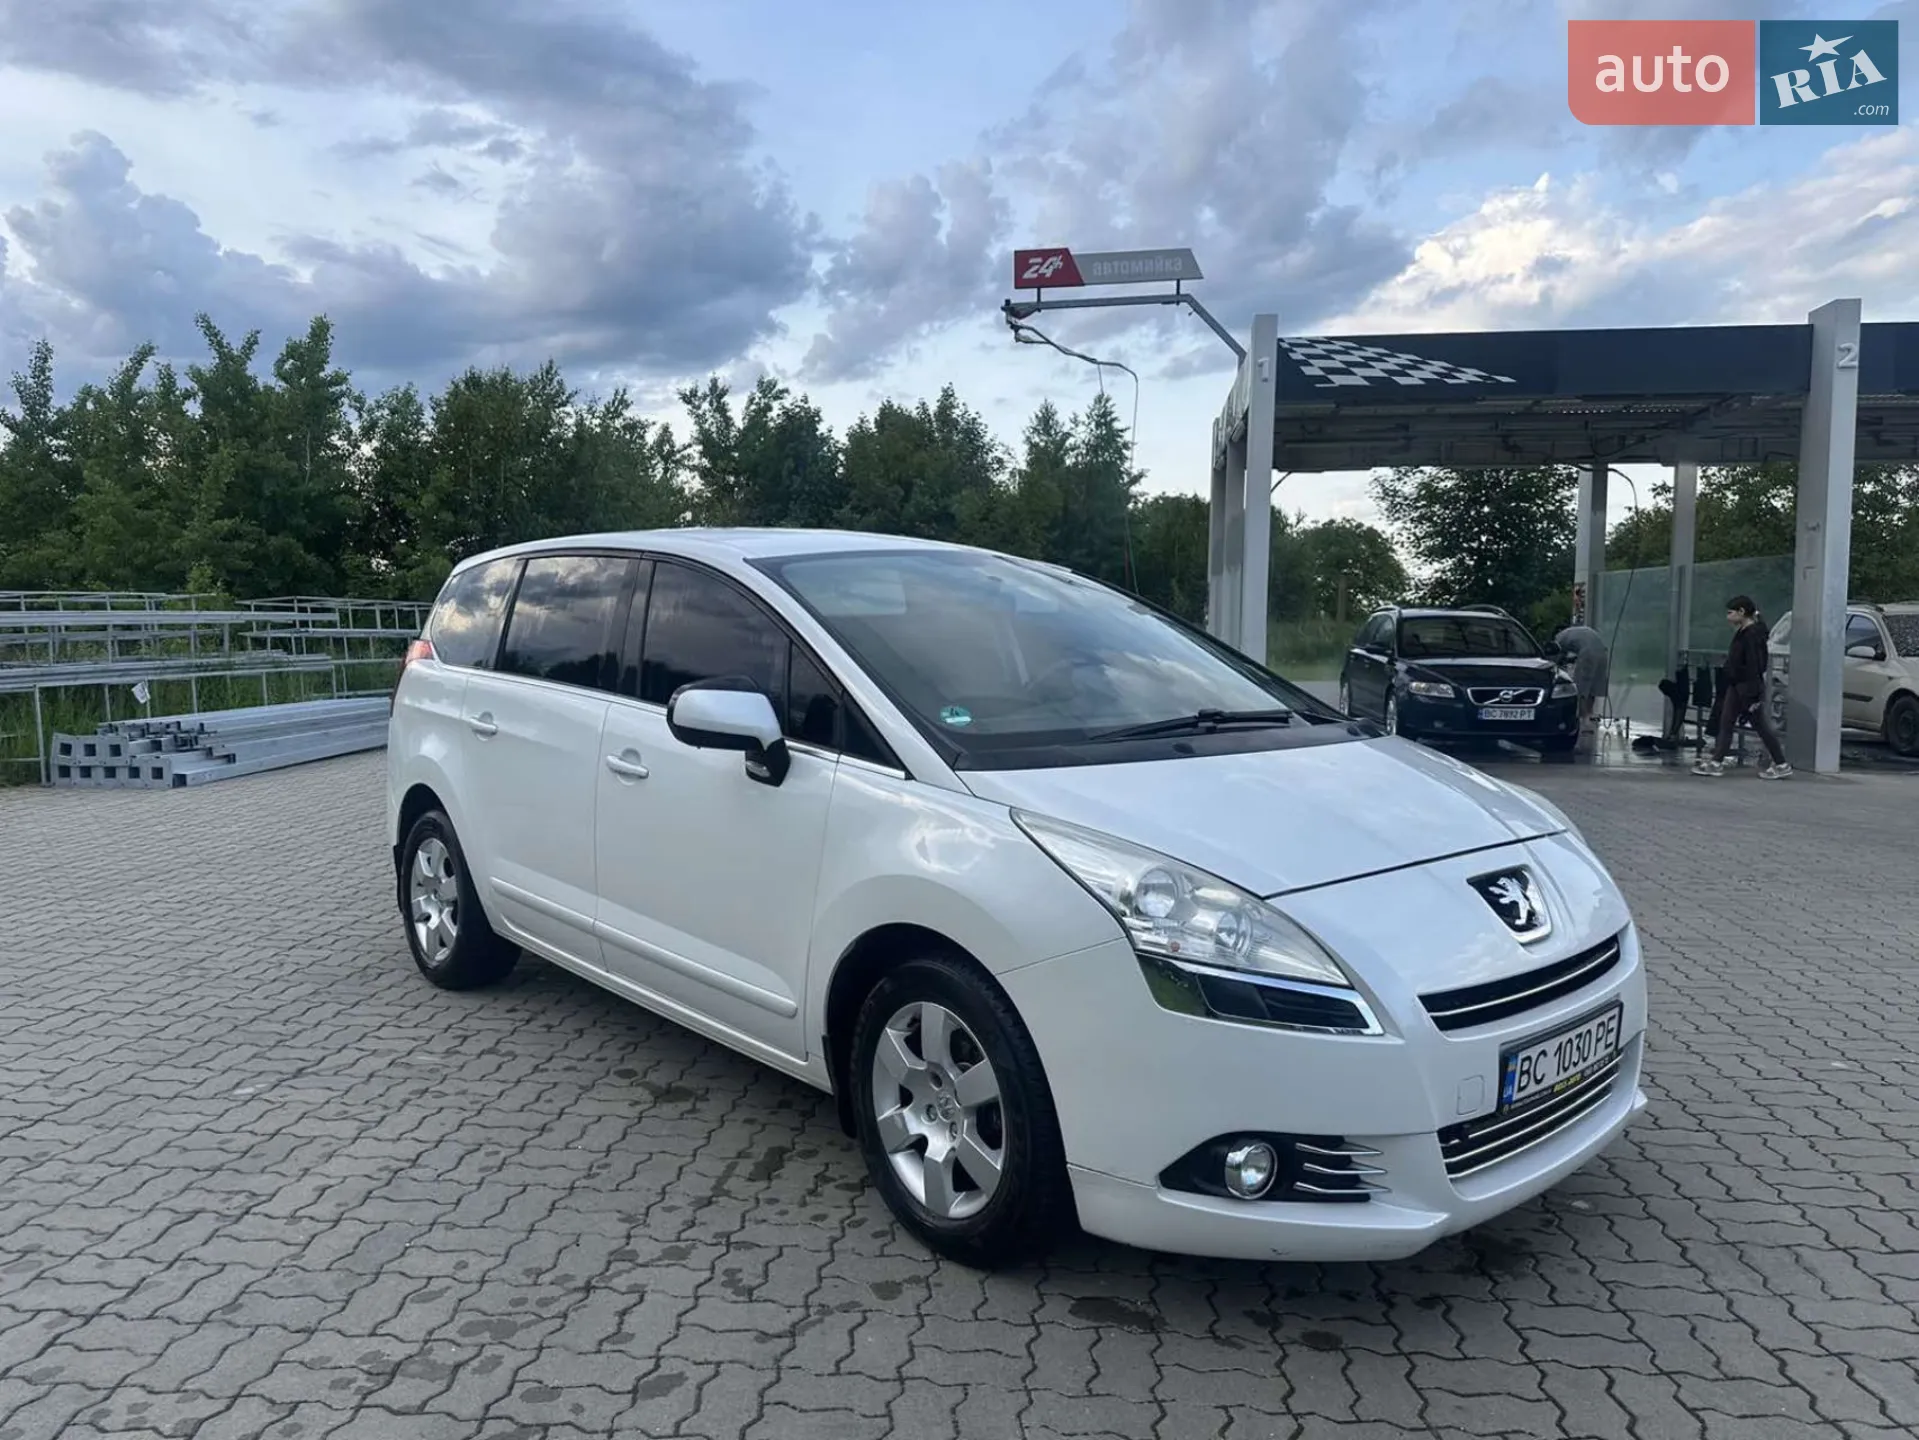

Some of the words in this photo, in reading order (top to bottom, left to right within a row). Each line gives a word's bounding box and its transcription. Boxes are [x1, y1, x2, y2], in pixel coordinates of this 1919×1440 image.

[1837, 342, 1859, 369] 2
[1257, 356, 1270, 383] 1
[1517, 1049, 1548, 1093] BC
[1554, 1028, 1592, 1077] 1030
[1594, 1013, 1616, 1057] PE
